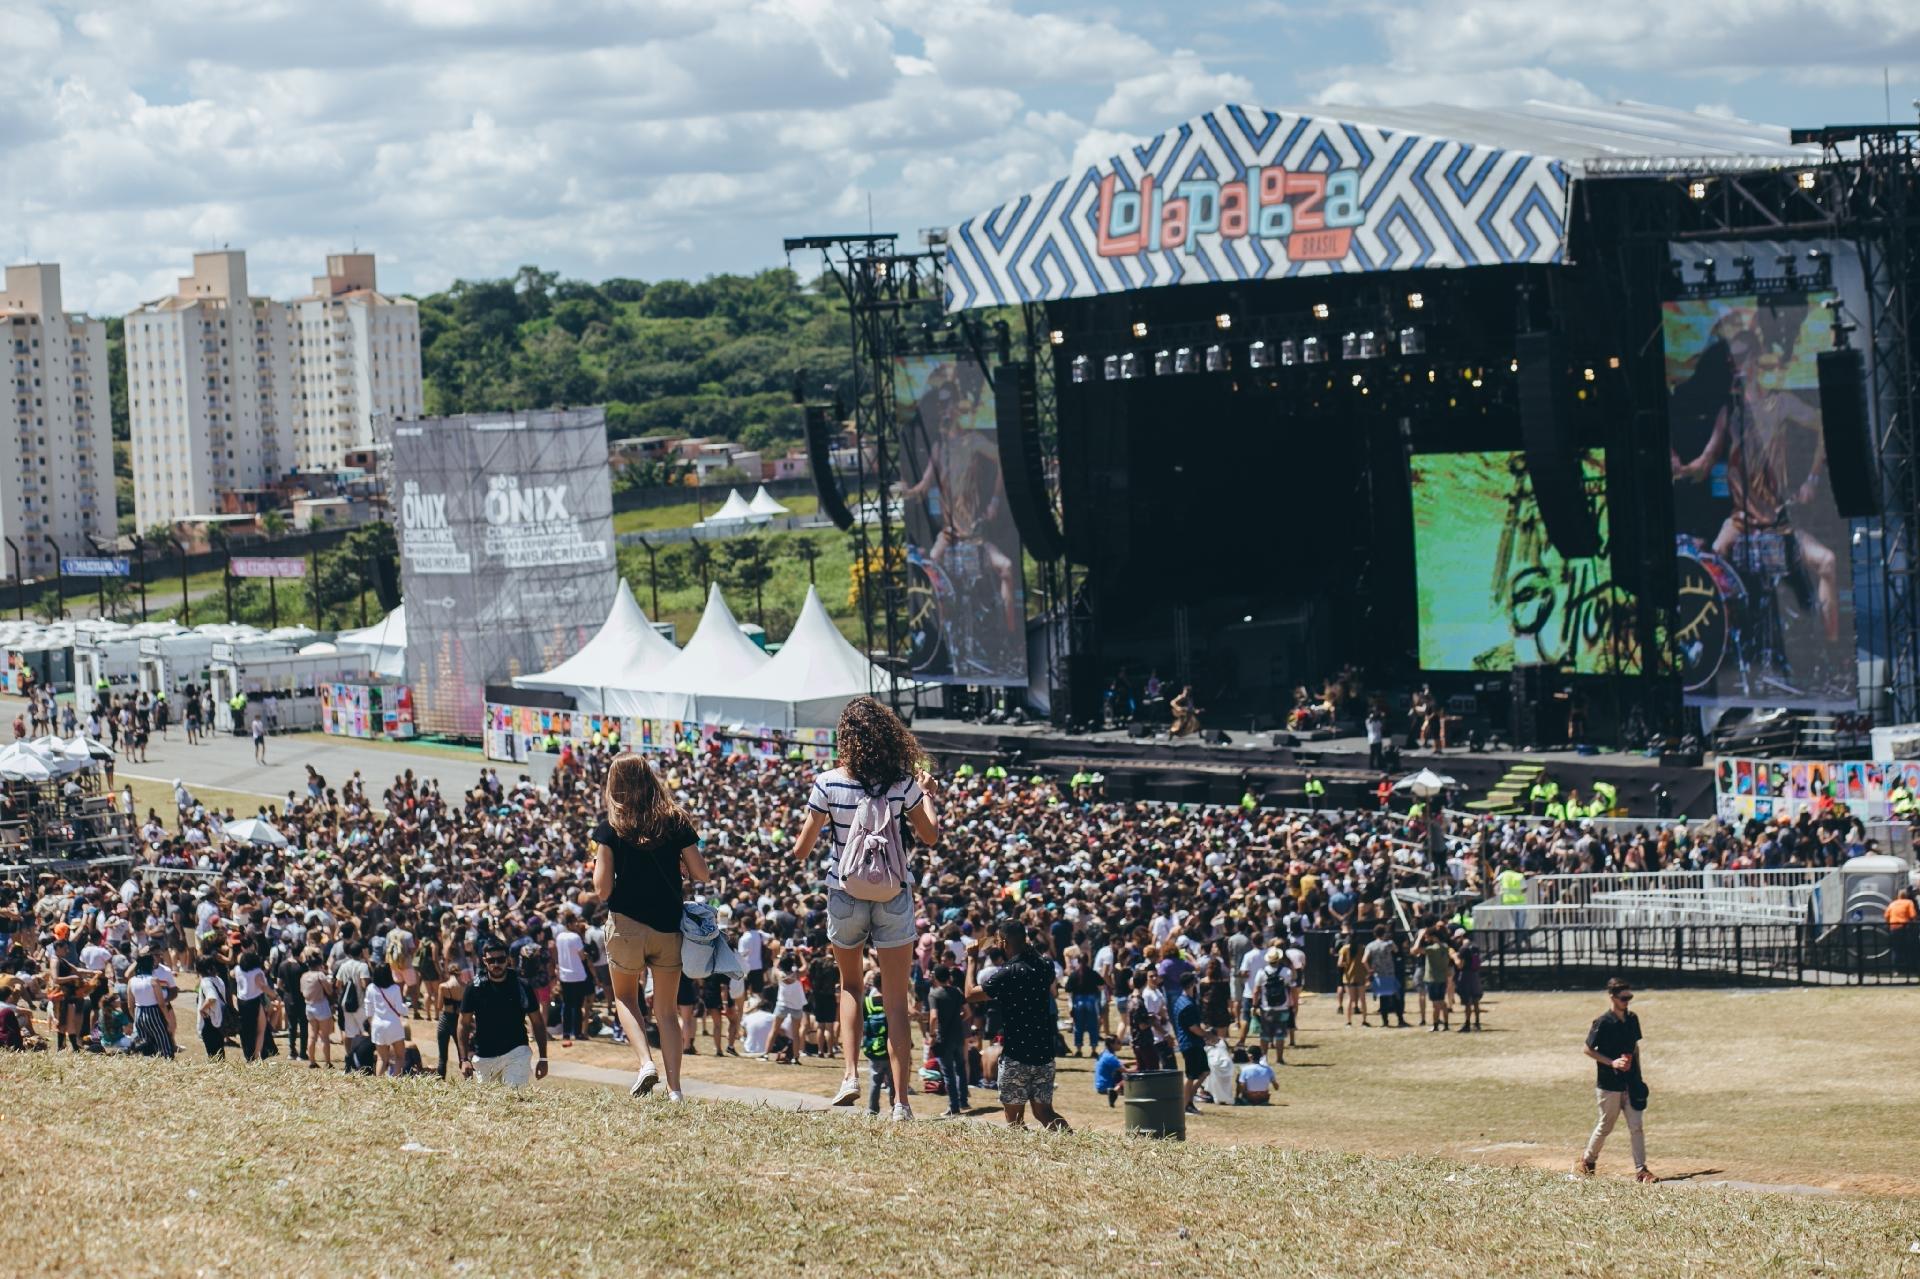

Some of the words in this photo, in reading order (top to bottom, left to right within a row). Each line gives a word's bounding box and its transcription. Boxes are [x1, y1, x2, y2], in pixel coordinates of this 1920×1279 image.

[1097, 165, 1365, 257] Lollapalooza
[1301, 235, 1338, 256] BRASIL
[402, 494, 448, 529] ONIX
[485, 485, 570, 525] ONIX
